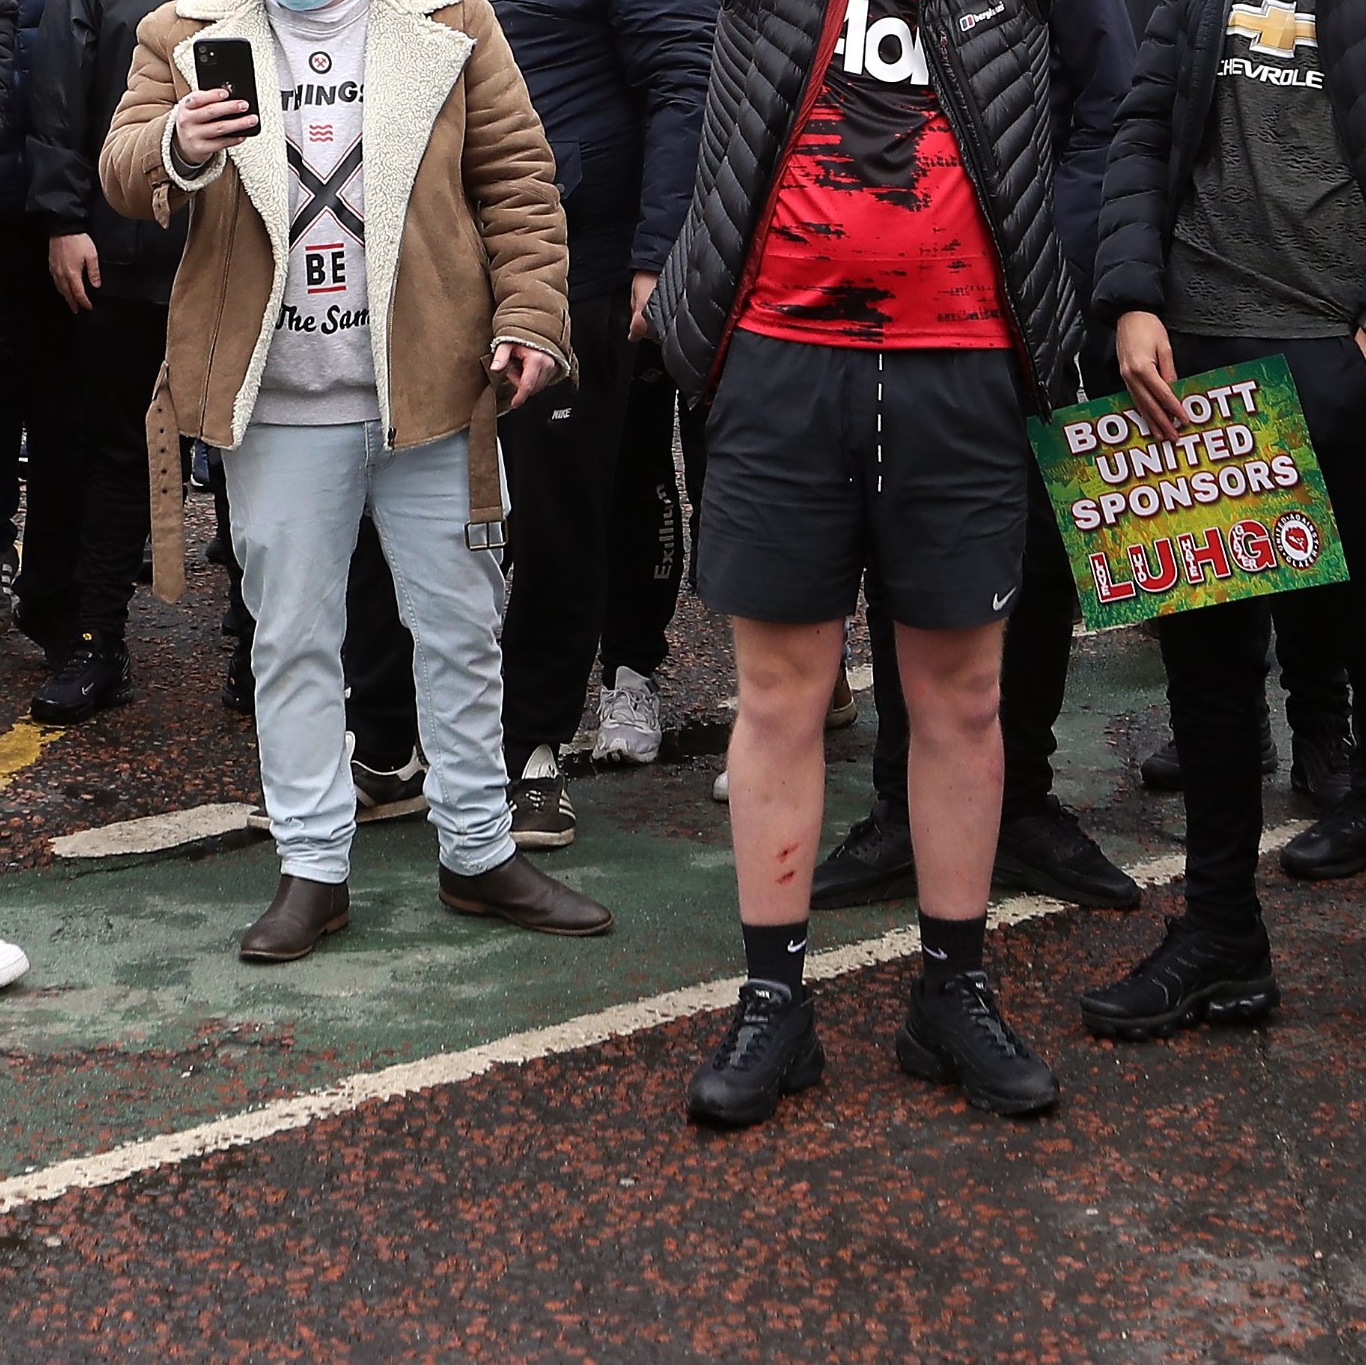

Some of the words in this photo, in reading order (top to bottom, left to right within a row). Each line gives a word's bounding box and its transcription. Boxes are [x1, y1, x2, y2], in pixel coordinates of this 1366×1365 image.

[1217, 58, 1325, 89] HEVROLE
[306, 251, 346, 285] BE
[275, 303, 317, 332] The
[321, 304, 370, 334] Sam
[552, 407, 572, 420] NIKE
[1063, 380, 1259, 455] BOYOTT
[1095, 424, 1255, 485] UNITED
[1071, 455, 1299, 531] SPONSORS
[1088, 520, 1277, 603] LUHG
[1132, 553, 1147, 583] UTD
[1181, 538, 1199, 577] HATE
[1094, 559, 1110, 596] LOVE
